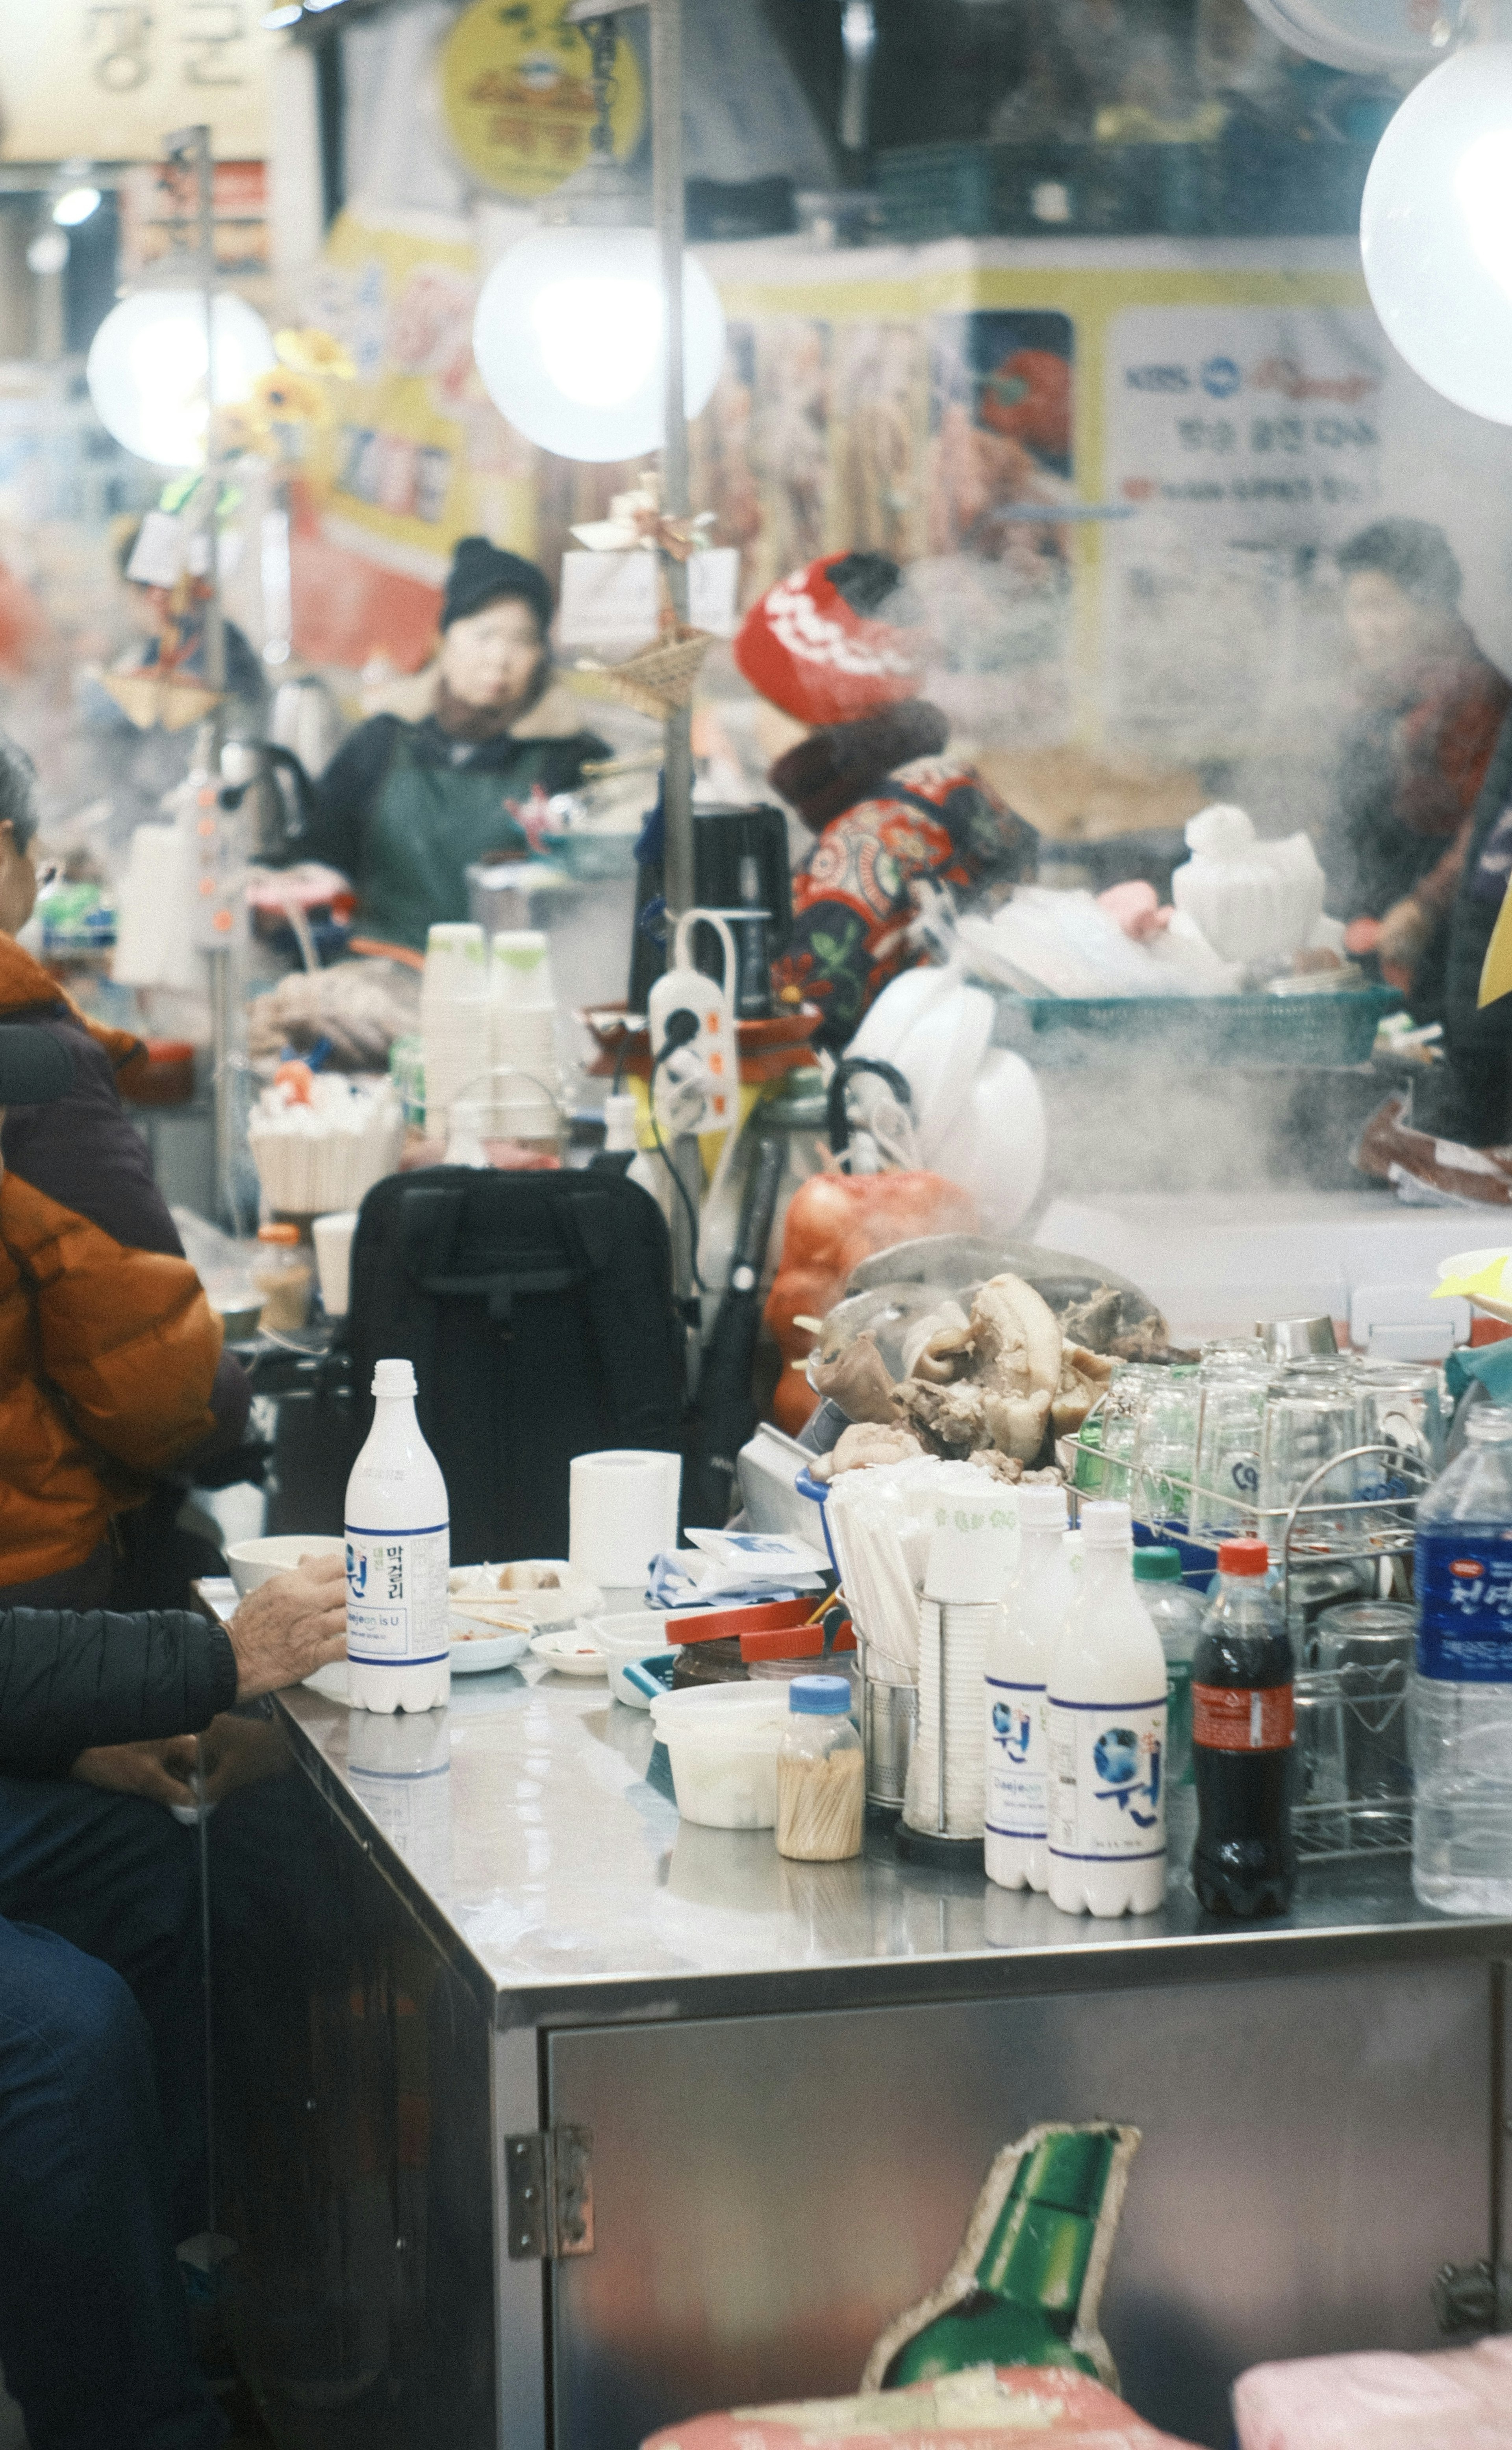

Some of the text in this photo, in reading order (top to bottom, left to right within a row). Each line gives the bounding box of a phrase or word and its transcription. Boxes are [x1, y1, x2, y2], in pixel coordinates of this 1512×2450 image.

[386, 1545, 404, 1599] 막걸리
[379, 1615, 388, 1625] is
[391, 1616, 400, 1627] U
